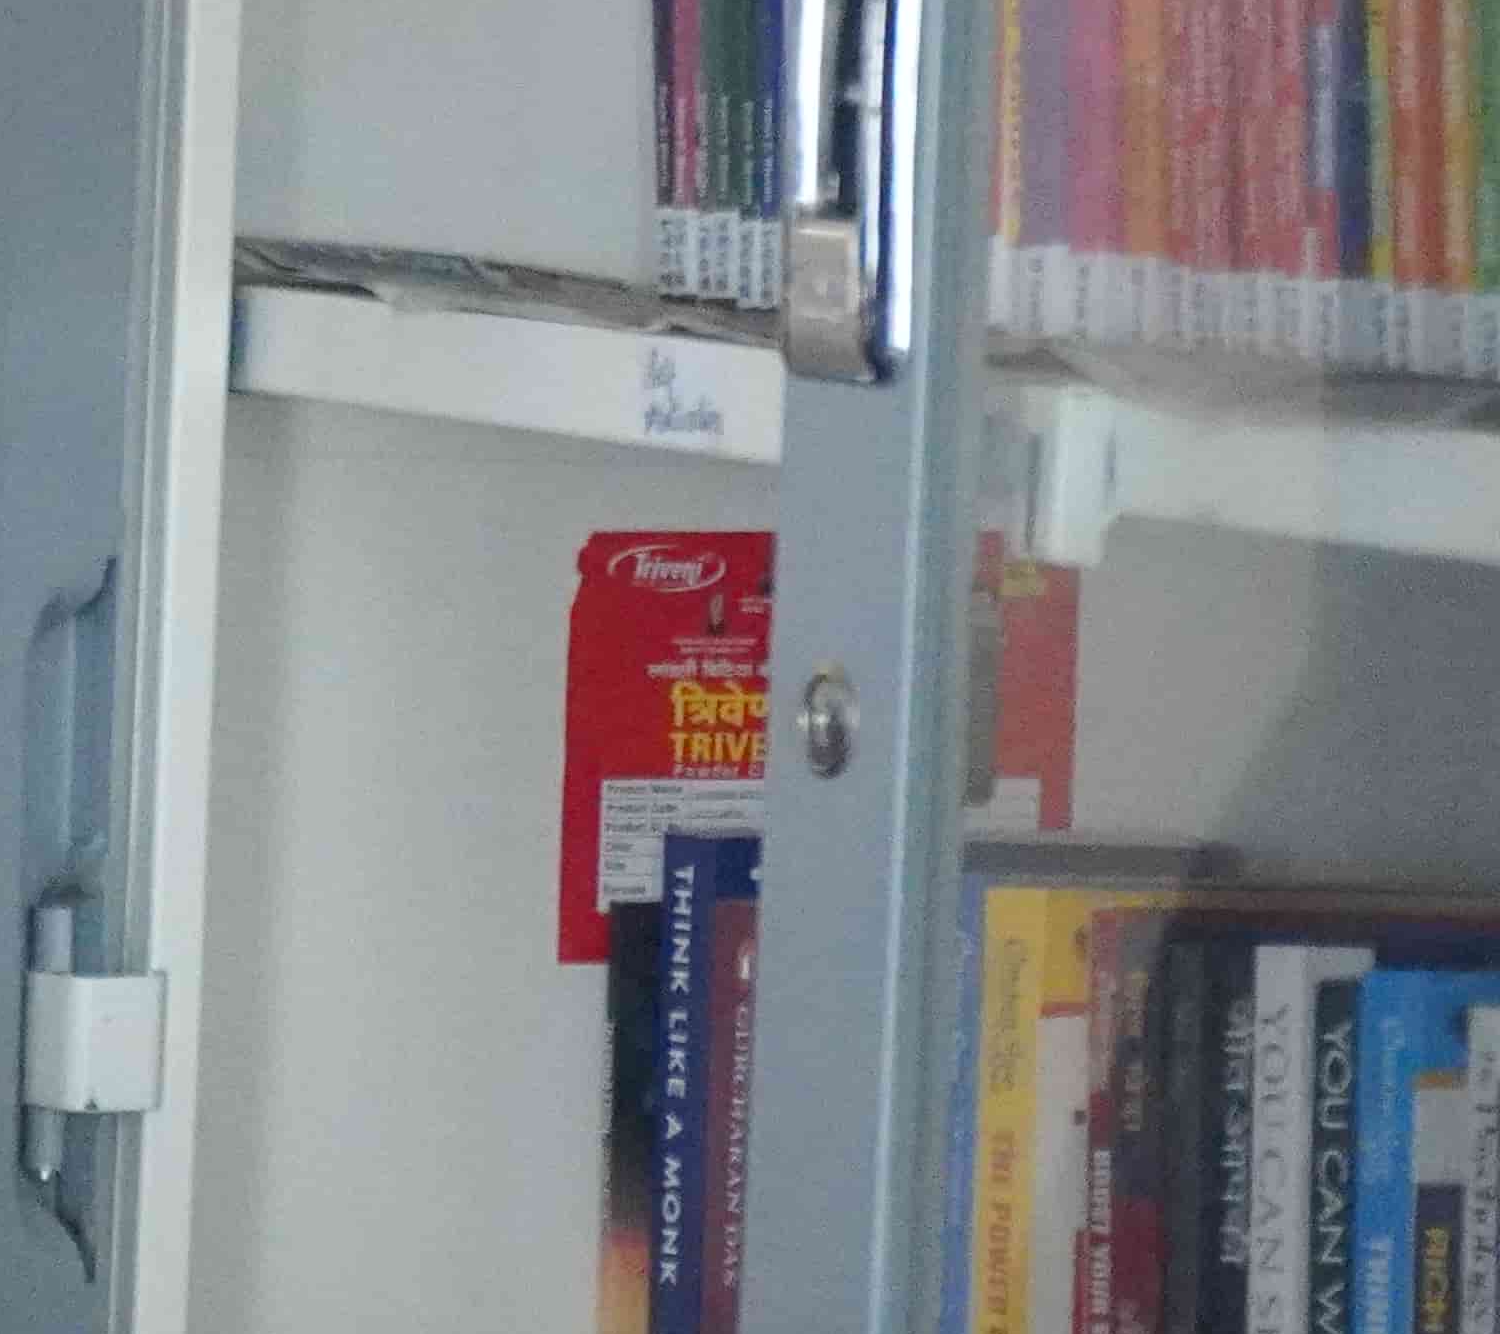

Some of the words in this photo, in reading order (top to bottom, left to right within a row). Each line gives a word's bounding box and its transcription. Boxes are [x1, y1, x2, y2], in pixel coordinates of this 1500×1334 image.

[668, 865, 695, 992] THINK
[664, 1009, 689, 1098] LIKE
[1256, 1005, 1291, 1131] YOU
[1319, 1021, 1354, 1130] YOU
[663, 1114, 684, 1141] A
[658, 1155, 683, 1287] MONK
[986, 1197, 1013, 1317] POWER
[1255, 1148, 1286, 1275] CAN
[1316, 1146, 1350, 1264] CAN
[1421, 1225, 1450, 1333] RICH
